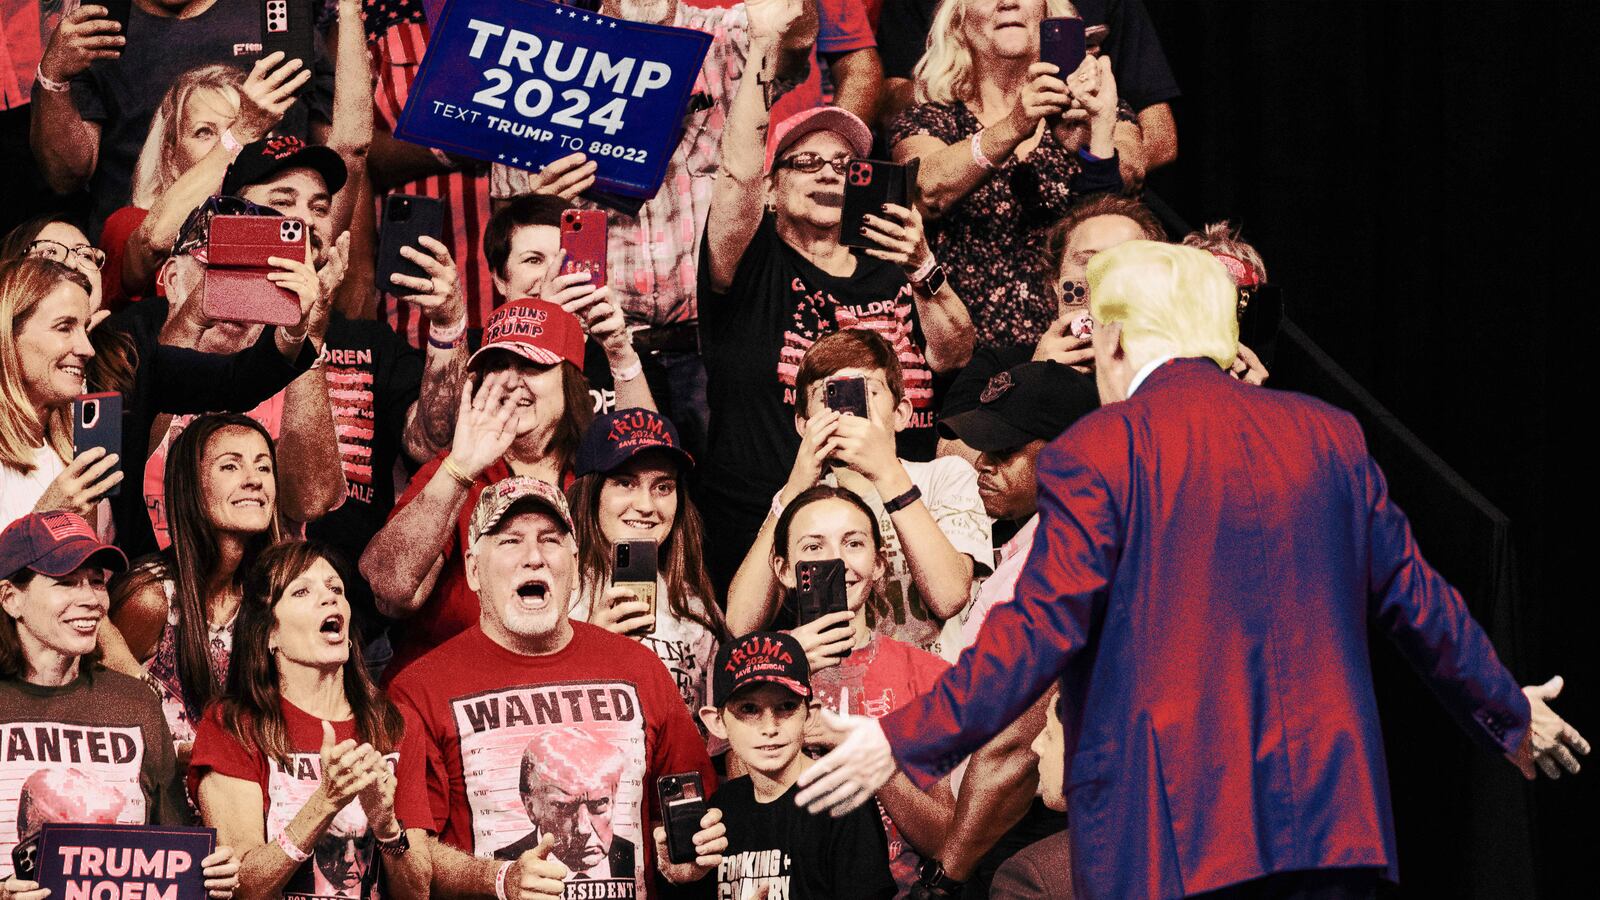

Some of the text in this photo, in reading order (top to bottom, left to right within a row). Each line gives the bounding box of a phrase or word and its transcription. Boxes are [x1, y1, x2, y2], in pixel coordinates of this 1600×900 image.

[467, 18, 672, 98] TRUMP
[472, 68, 628, 136] 2024
[432, 100, 648, 165] TEXT TRUMP TO 88022
[507, 306, 548, 323] GUNS
[607, 415, 673, 448] TRUMP
[724, 640, 793, 673] TRUMP
[734, 663, 785, 680] SAVE AMERICA!
[745, 655, 770, 667] 2024
[463, 688, 635, 734] WANTED
[0, 727, 137, 765] ANTED
[58, 846, 193, 880] TRUMP
[66, 879, 178, 900] NOEM
[560, 881, 634, 899] ESIDENT
